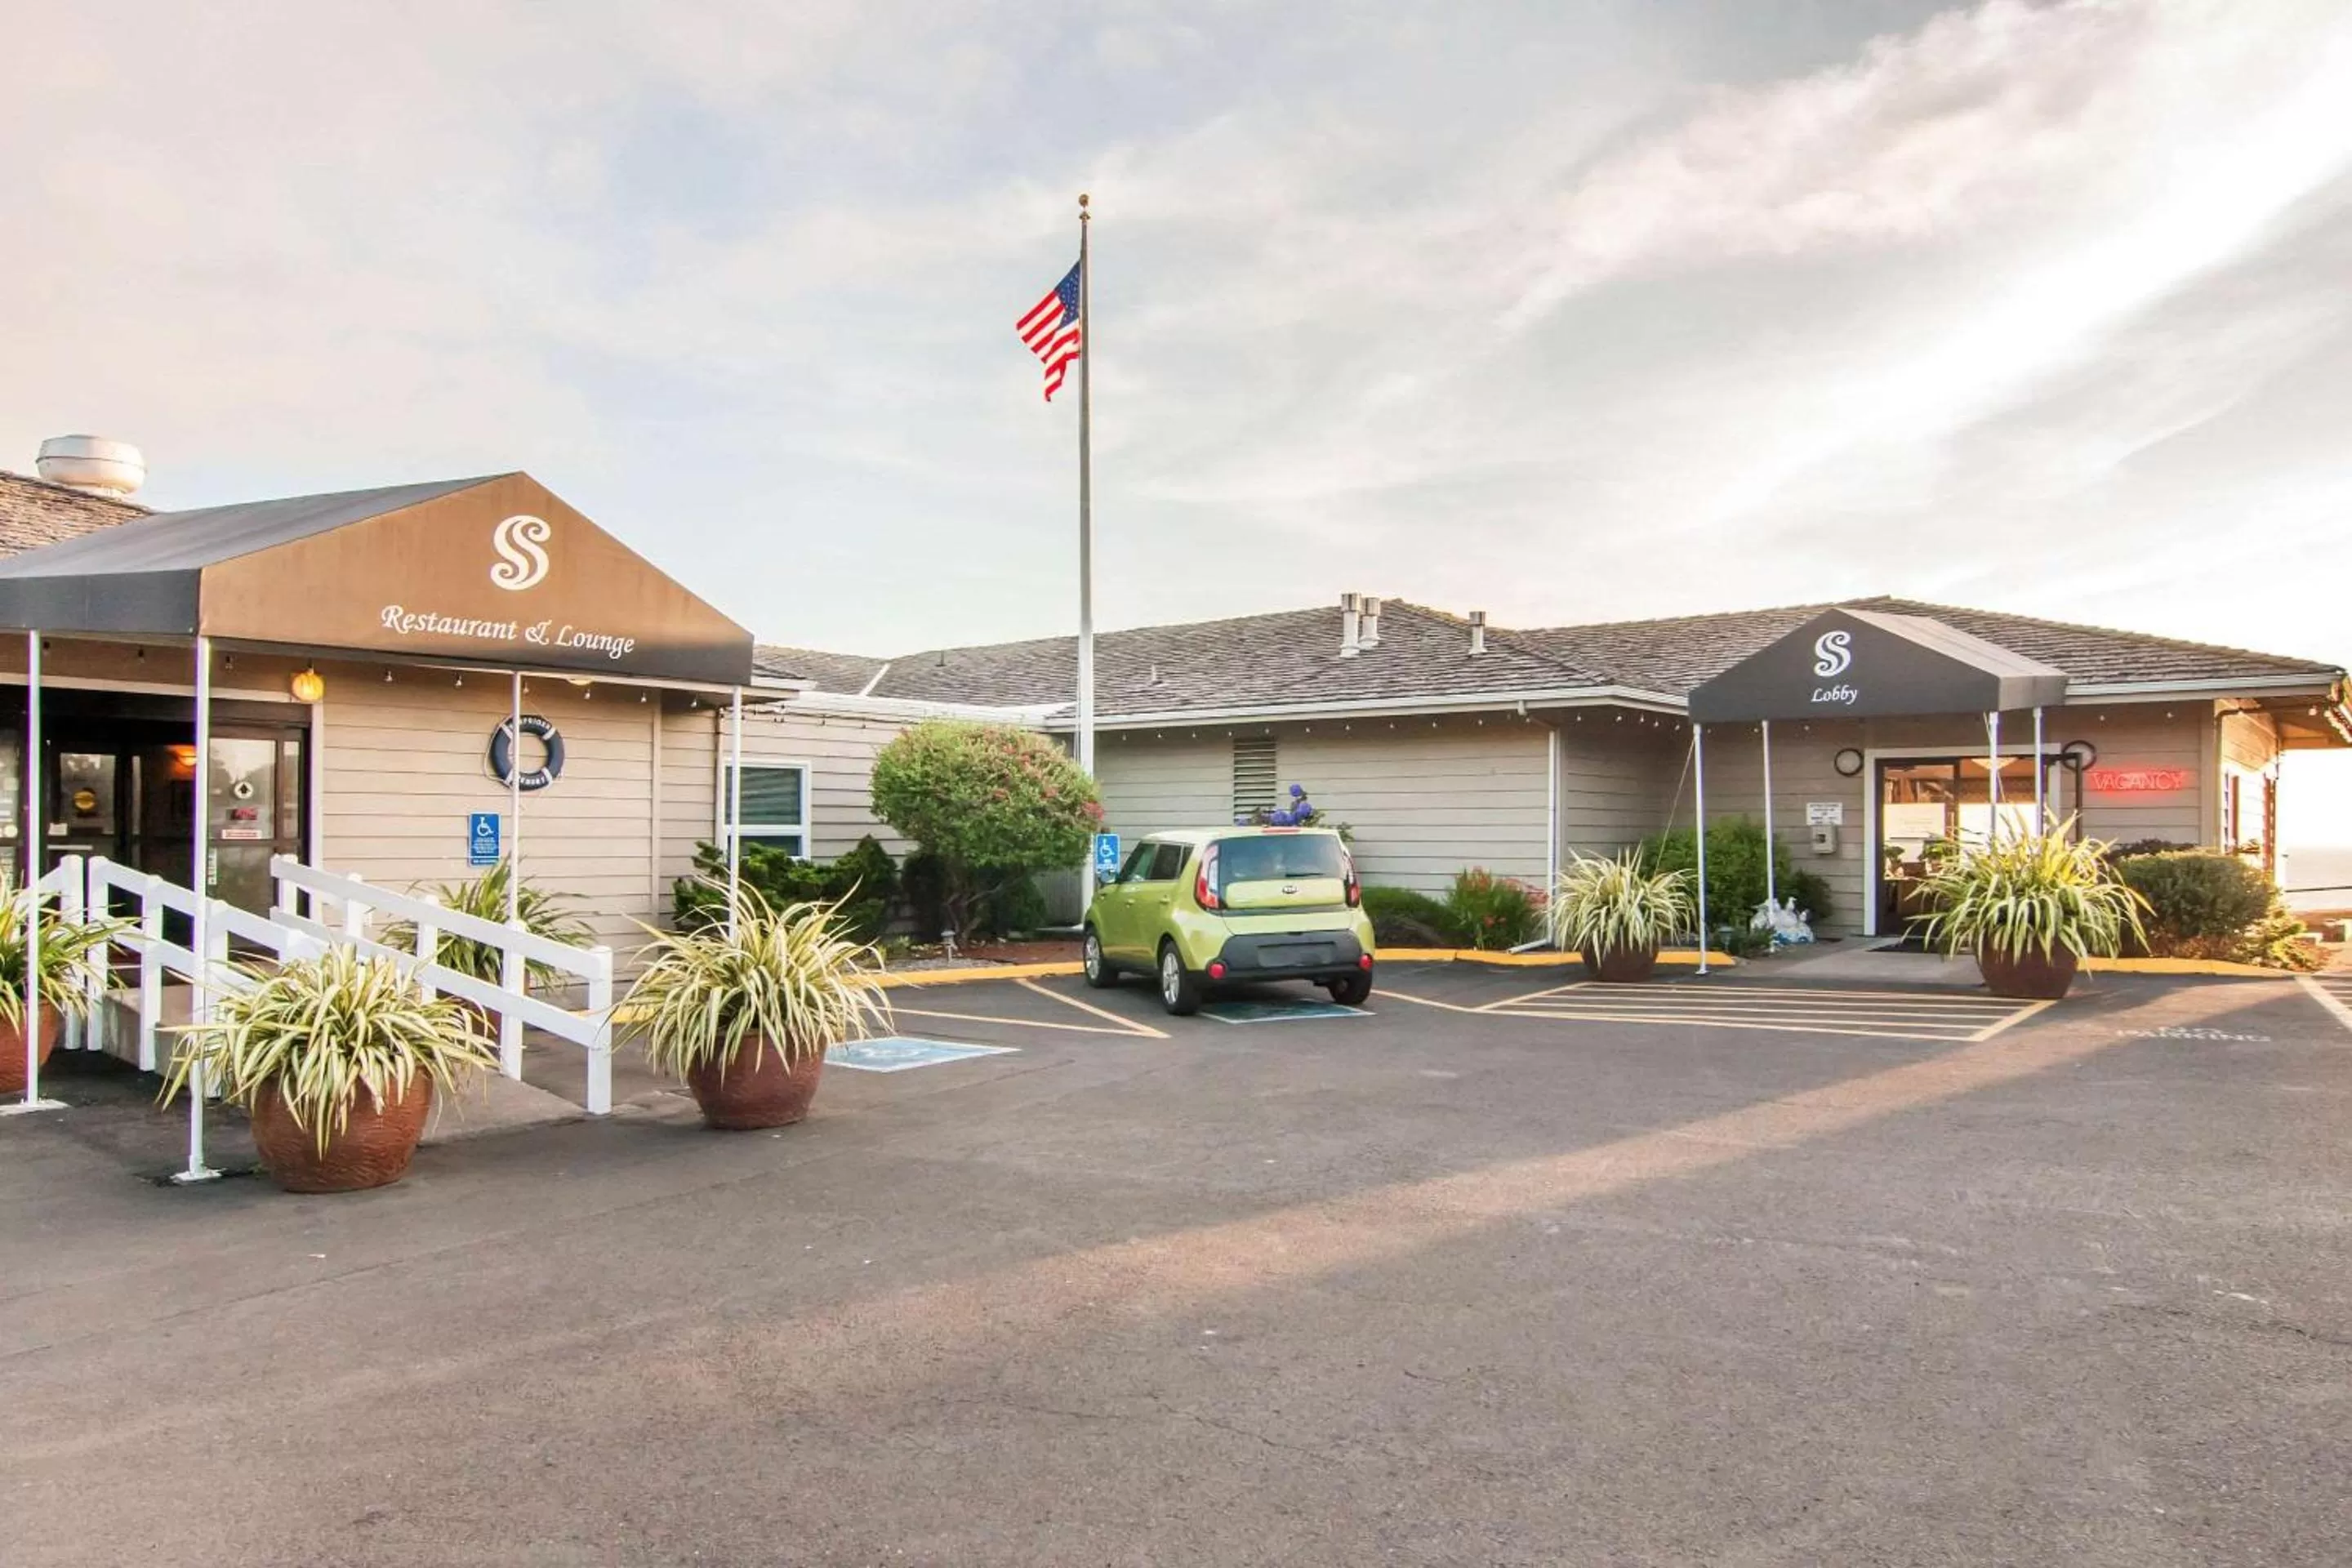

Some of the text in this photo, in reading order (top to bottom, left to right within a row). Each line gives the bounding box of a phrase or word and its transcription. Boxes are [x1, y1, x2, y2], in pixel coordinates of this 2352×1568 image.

[381, 604, 635, 659] Restaurant & Lounge
[1811, 684, 1858, 705] Lobby
[2092, 771, 2184, 790] VACANCY
